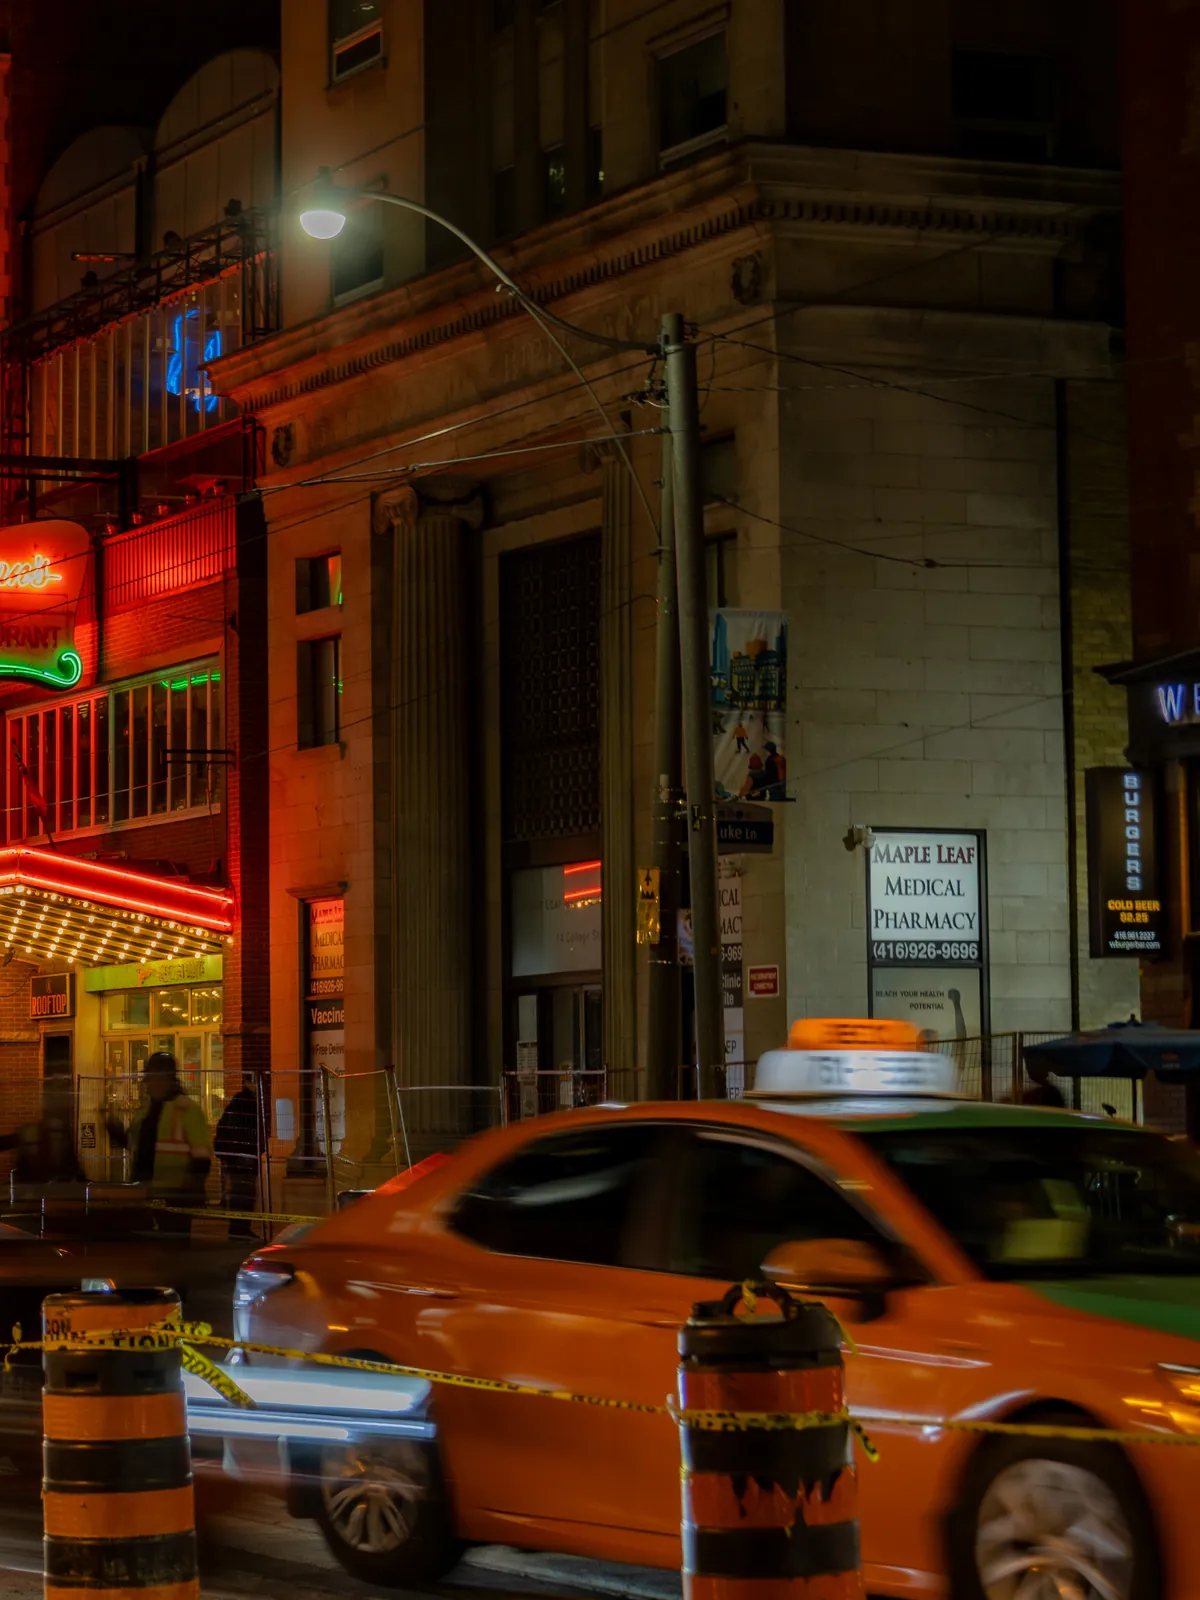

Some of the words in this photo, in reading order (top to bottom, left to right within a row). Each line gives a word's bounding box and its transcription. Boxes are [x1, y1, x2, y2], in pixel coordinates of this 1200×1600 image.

[717, 823, 742, 841] uke
[1123, 774, 1142, 891] BURGERS
[873, 844, 931, 864] MAPLE
[937, 844, 975, 864] LEAF
[884, 875, 965, 896] MEDICAL
[1107, 900, 1132, 911] COLD
[1135, 899, 1161, 912] BEER
[874, 909, 976, 930] PHARMACY
[873, 942, 978, 961] (416)926-9696
[31, 994, 67, 1016] ROOFTOP
